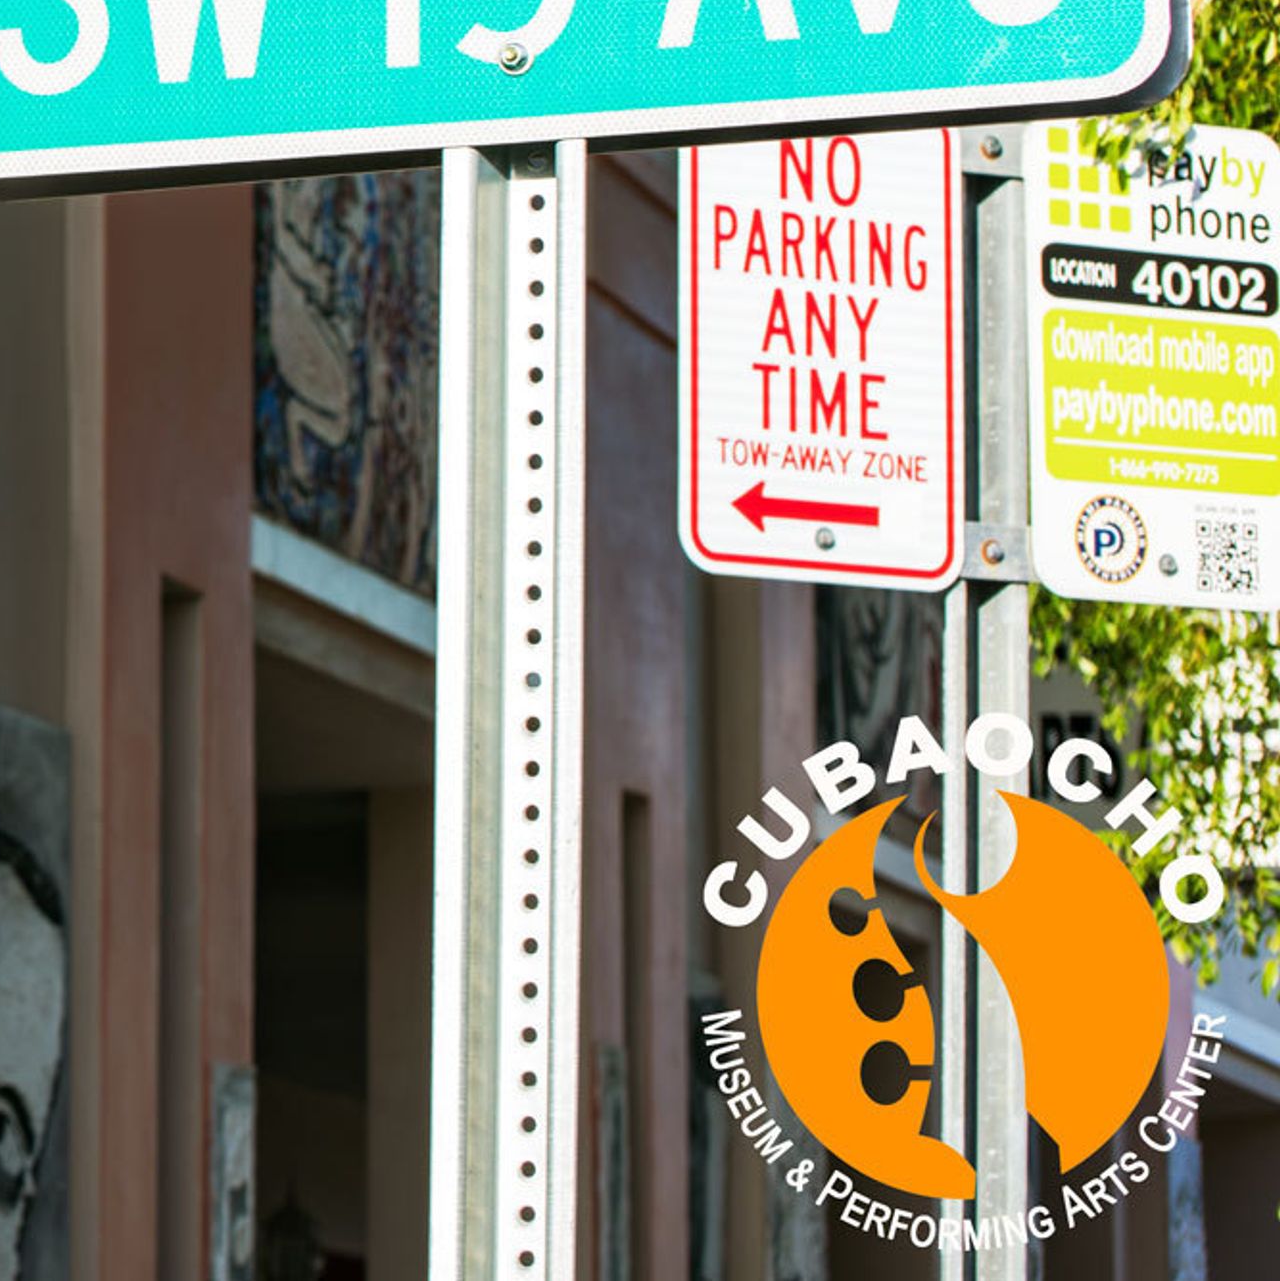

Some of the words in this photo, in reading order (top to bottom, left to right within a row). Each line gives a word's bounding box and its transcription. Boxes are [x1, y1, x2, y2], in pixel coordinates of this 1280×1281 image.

[780, 134, 862, 207] NO
[714, 204, 928, 292] PARKING
[1149, 194, 1270, 244] phone
[1049, 256, 1117, 289] LOCATION
[1131, 259, 1269, 313] 40102
[762, 287, 879, 362] ANY
[1051, 315, 1154, 368] download
[1159, 327, 1230, 376] mobile
[1235, 341, 1275, 389] app
[752, 362, 888, 441] TIME
[1051, 378, 1277, 438] paybyphone.com
[717, 437, 853, 476] TOW-AWAY
[863, 450, 928, 483] ZONE
